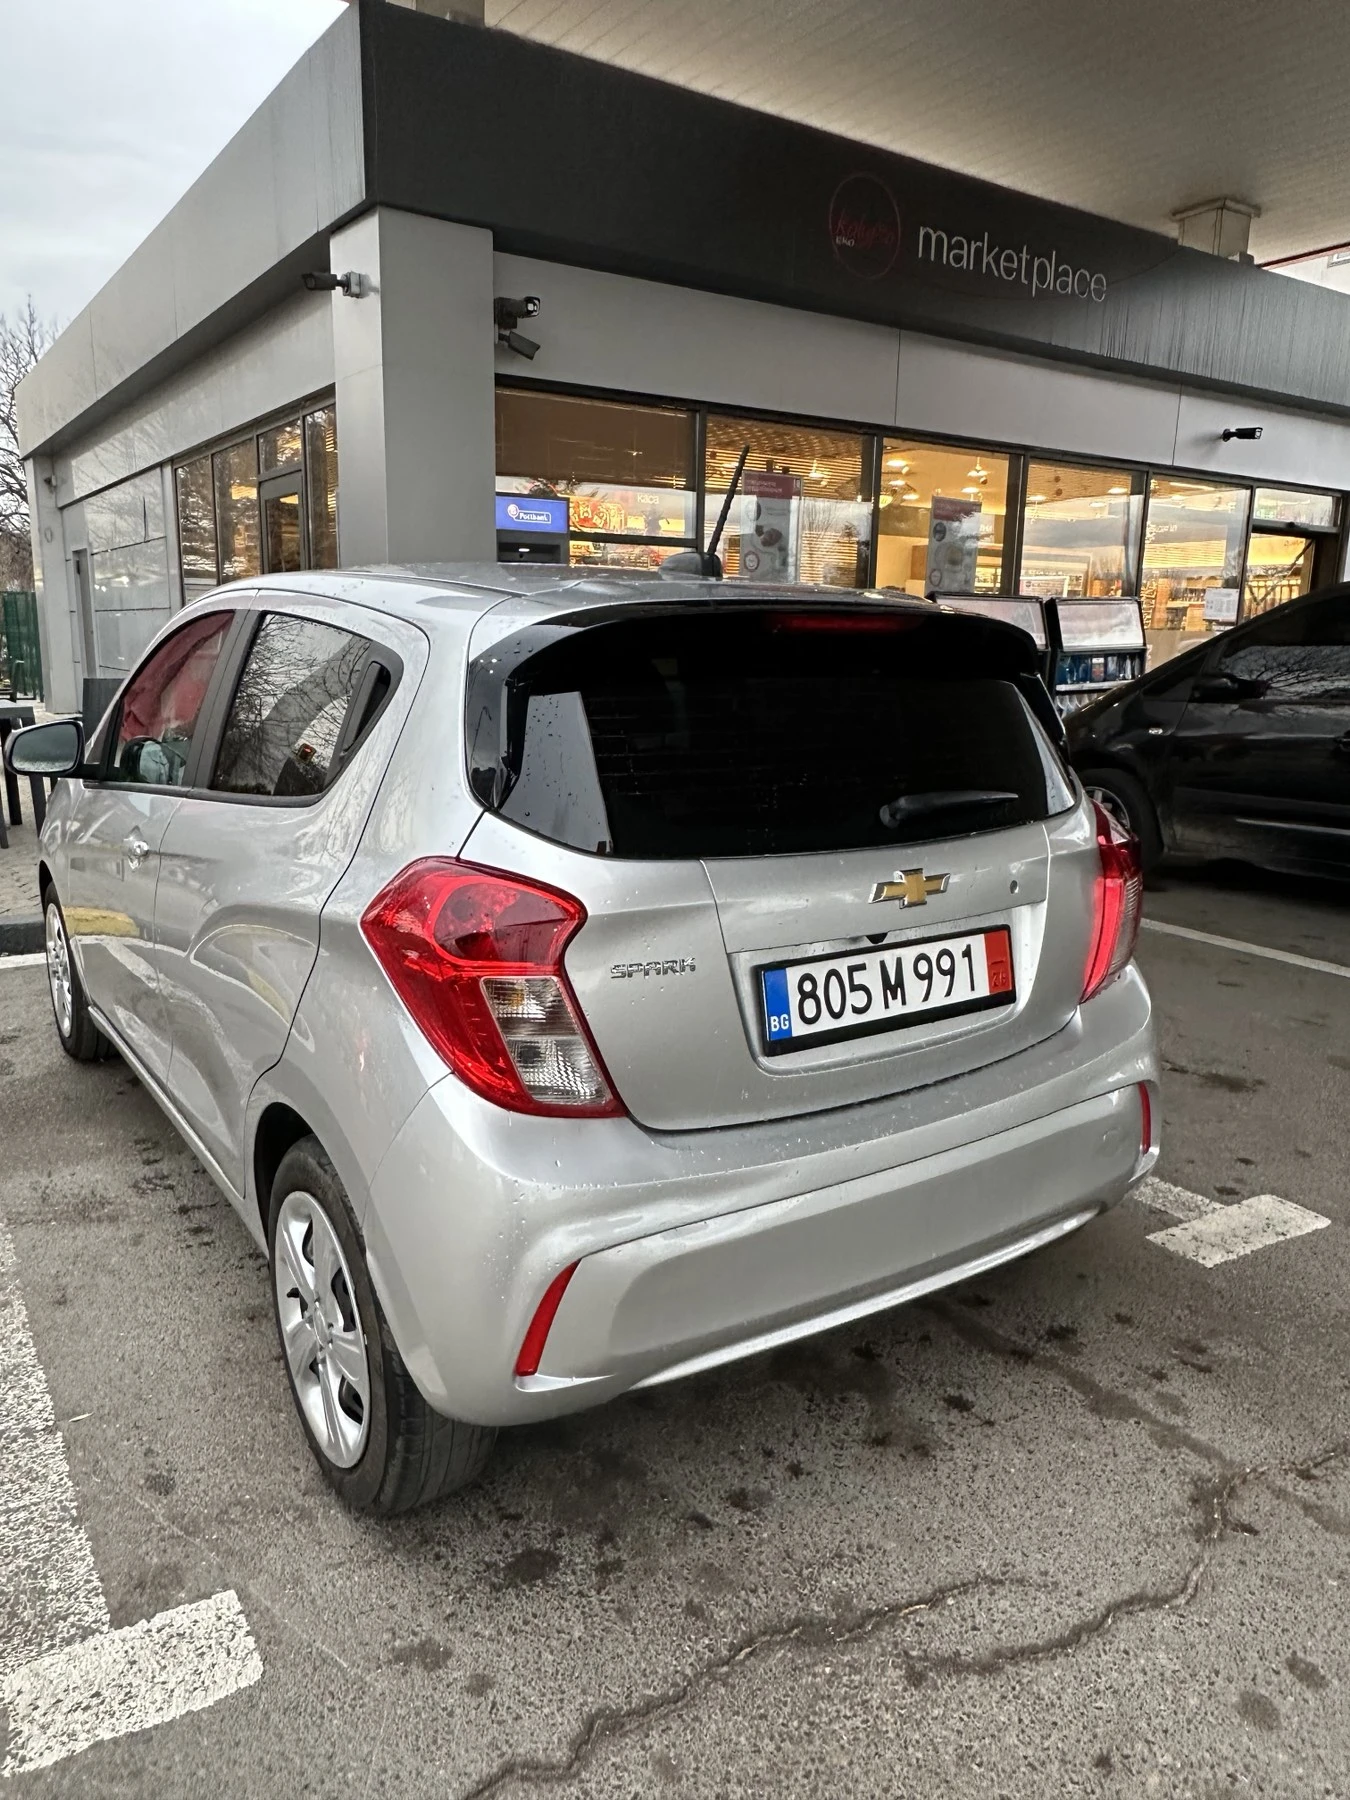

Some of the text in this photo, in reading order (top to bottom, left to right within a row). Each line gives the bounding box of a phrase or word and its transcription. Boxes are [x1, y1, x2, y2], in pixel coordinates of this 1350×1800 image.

[918, 225, 1107, 302] marketplace
[610, 957, 696, 979] SPARK
[770, 1014, 789, 1032] BG
